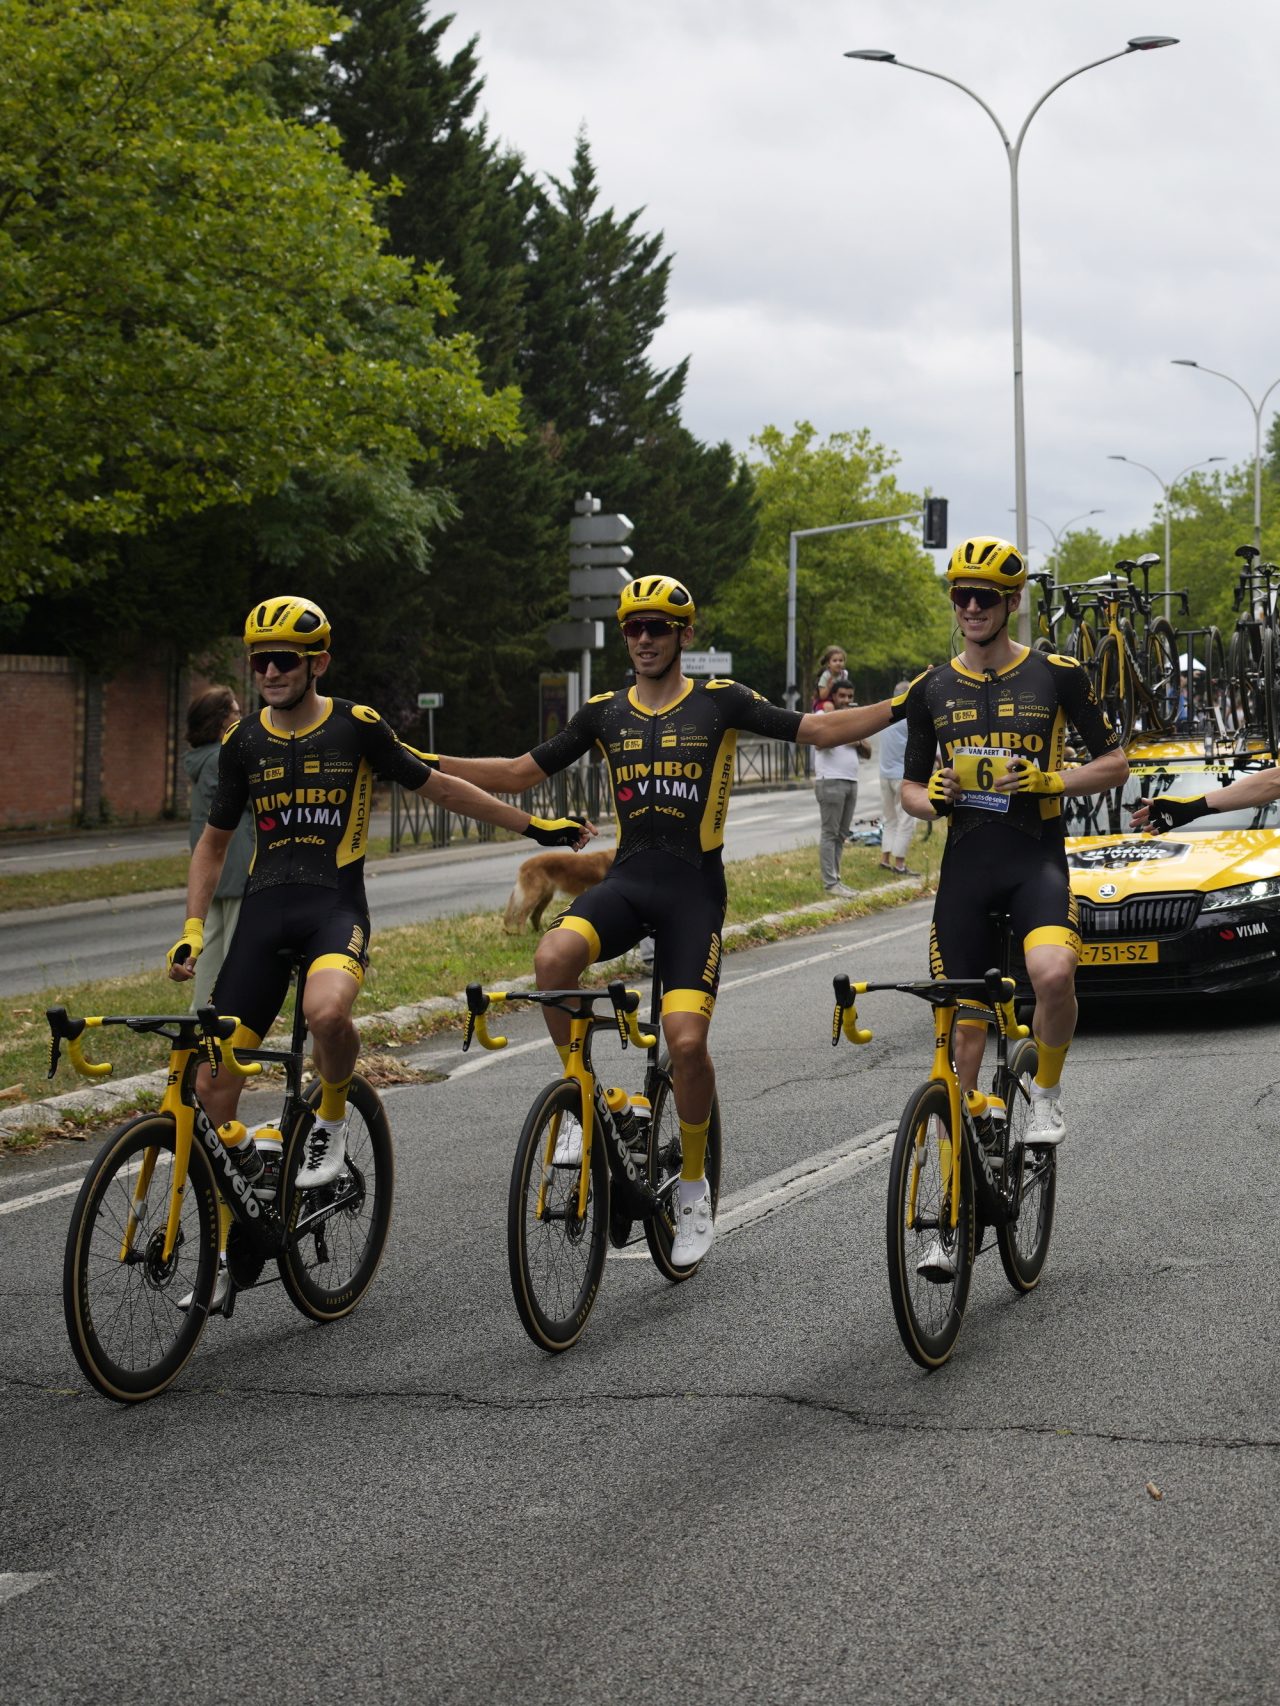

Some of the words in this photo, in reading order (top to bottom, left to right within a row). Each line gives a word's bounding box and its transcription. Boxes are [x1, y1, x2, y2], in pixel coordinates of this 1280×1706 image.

[956, 678, 981, 689] JUMBO
[968, 748, 984, 759] VAN
[986, 749, 1000, 760] AERT
[616, 761, 703, 785] JUMBO
[976, 757, 993, 791] 6
[255, 788, 348, 815] JUMBO
[637, 779, 699, 803] VISMA
[280, 807, 341, 827] VISMA
[628, 804, 687, 820] cervélo
[268, 834, 327, 850] cervélo
[1235, 922, 1269, 938] VISMA
[702, 932, 721, 988] JUMBO
[1079, 944, 1149, 963] -751-SZ
[462, 1011, 474, 1042] SRAM
[614, 1008, 628, 1041] SRAM
[831, 1006, 842, 1039] SRAM
[993, 1002, 1007, 1036] SRAM
[205, 1036, 217, 1071] SRAM
[196, 1107, 261, 1219] cervélo
